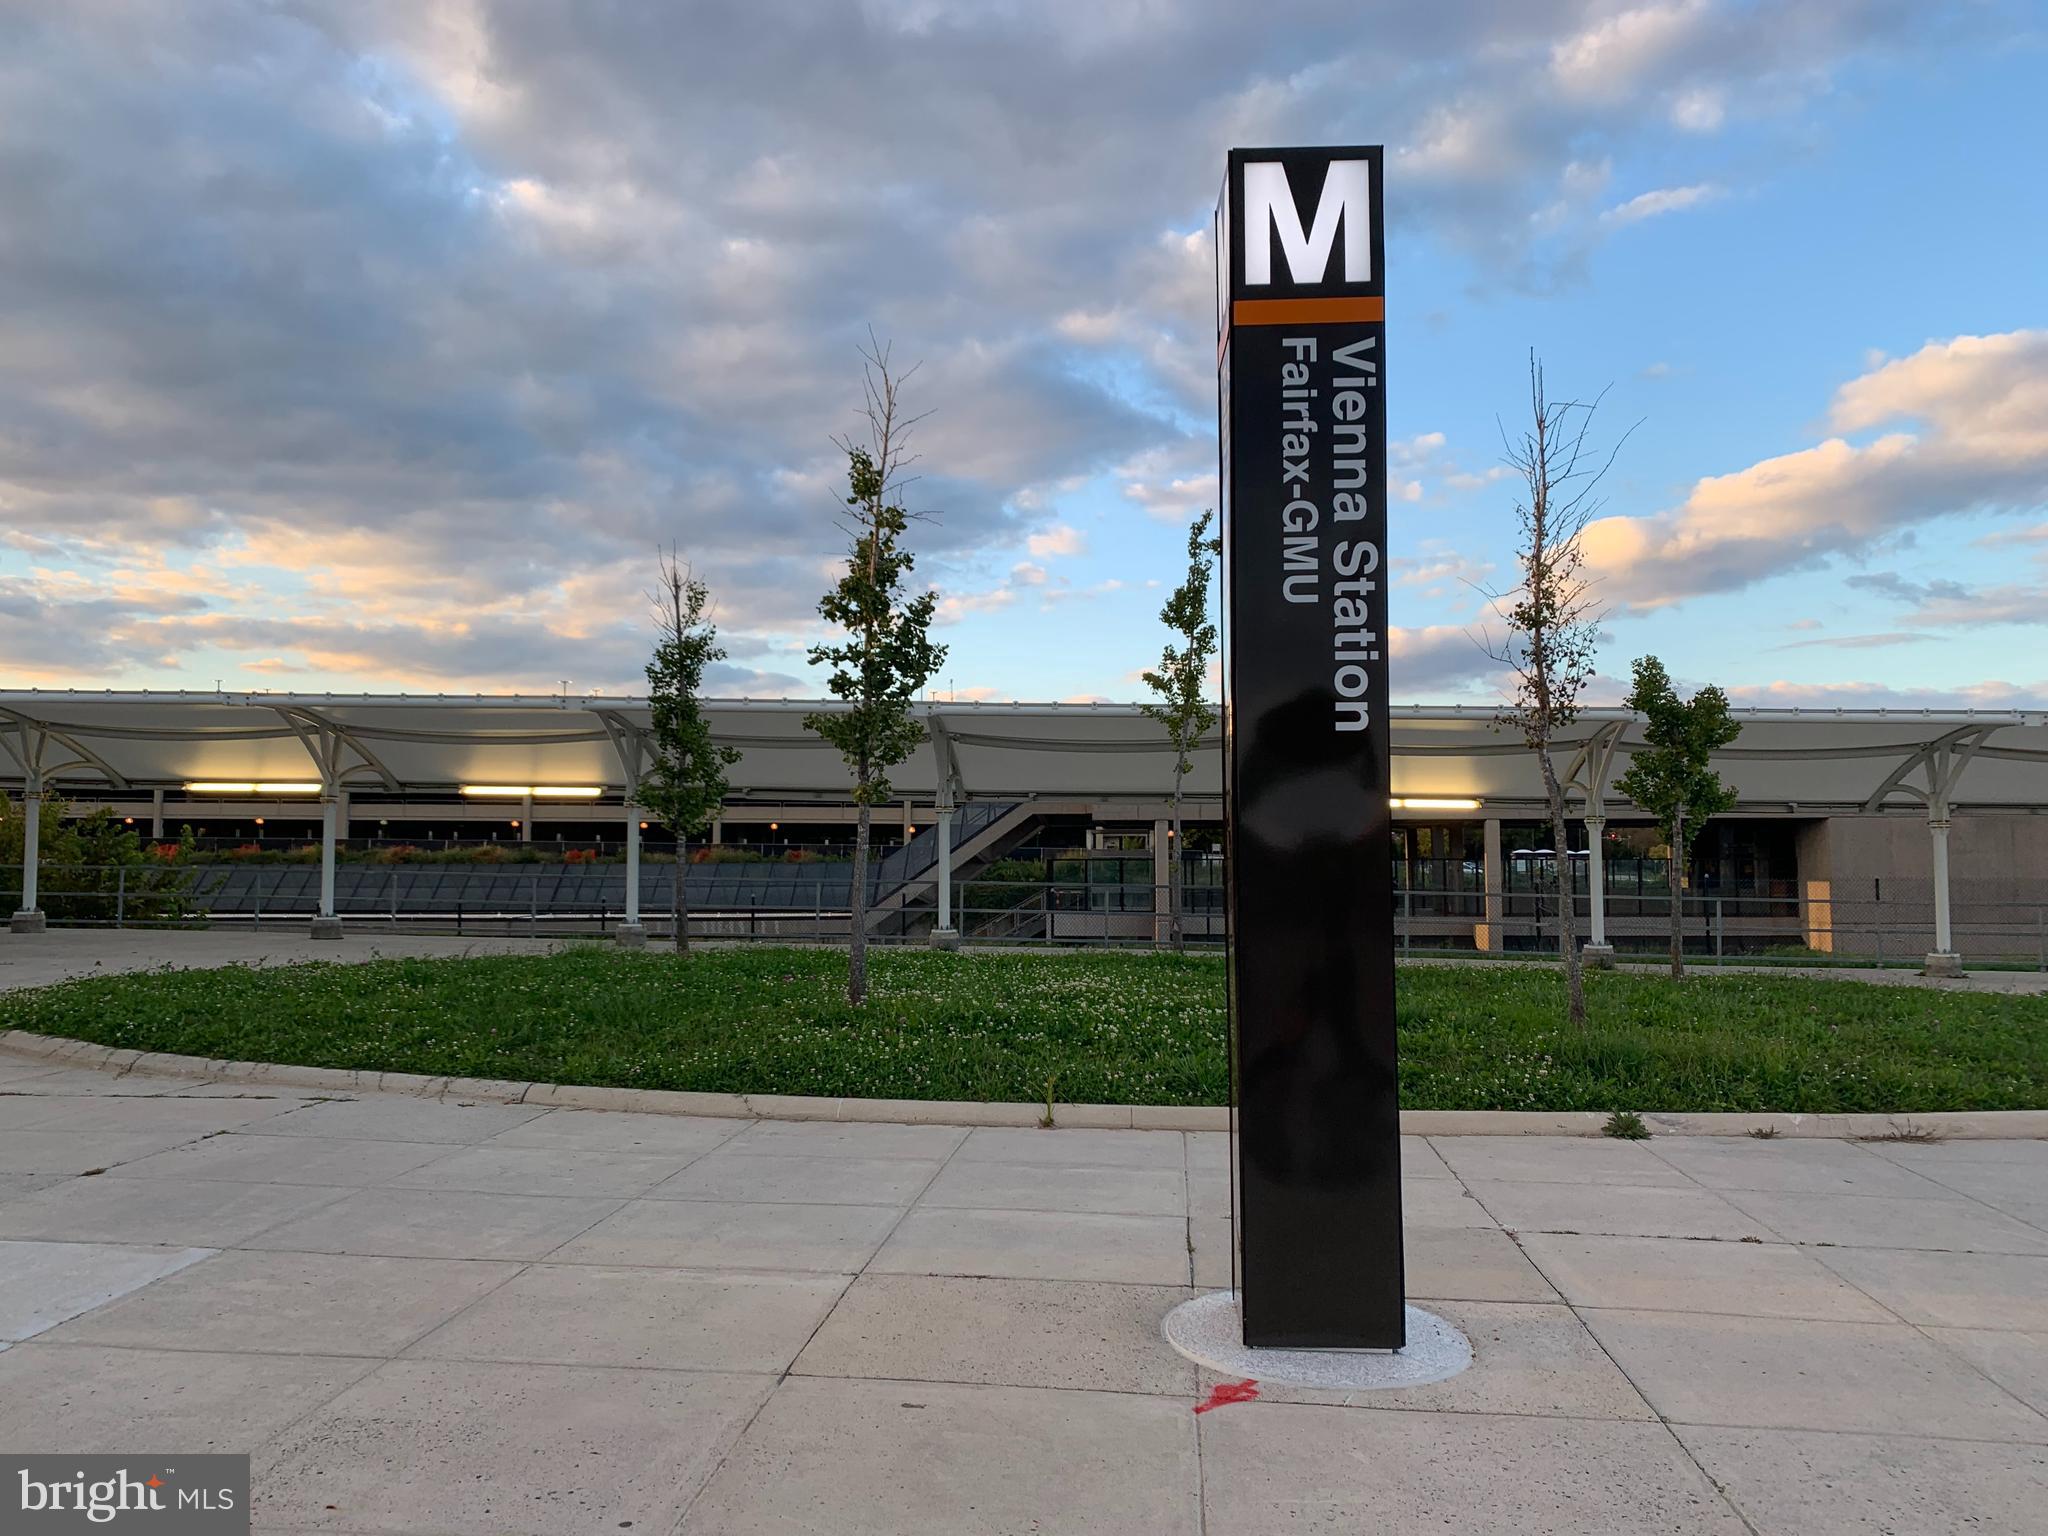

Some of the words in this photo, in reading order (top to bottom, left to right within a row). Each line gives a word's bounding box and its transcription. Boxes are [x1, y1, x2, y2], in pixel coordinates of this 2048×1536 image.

[1244, 160, 1372, 285] M
[1282, 338, 1318, 603] Fairfax-GMU
[1333, 337, 1377, 522] Vienna
[1333, 541, 1379, 731] Station
